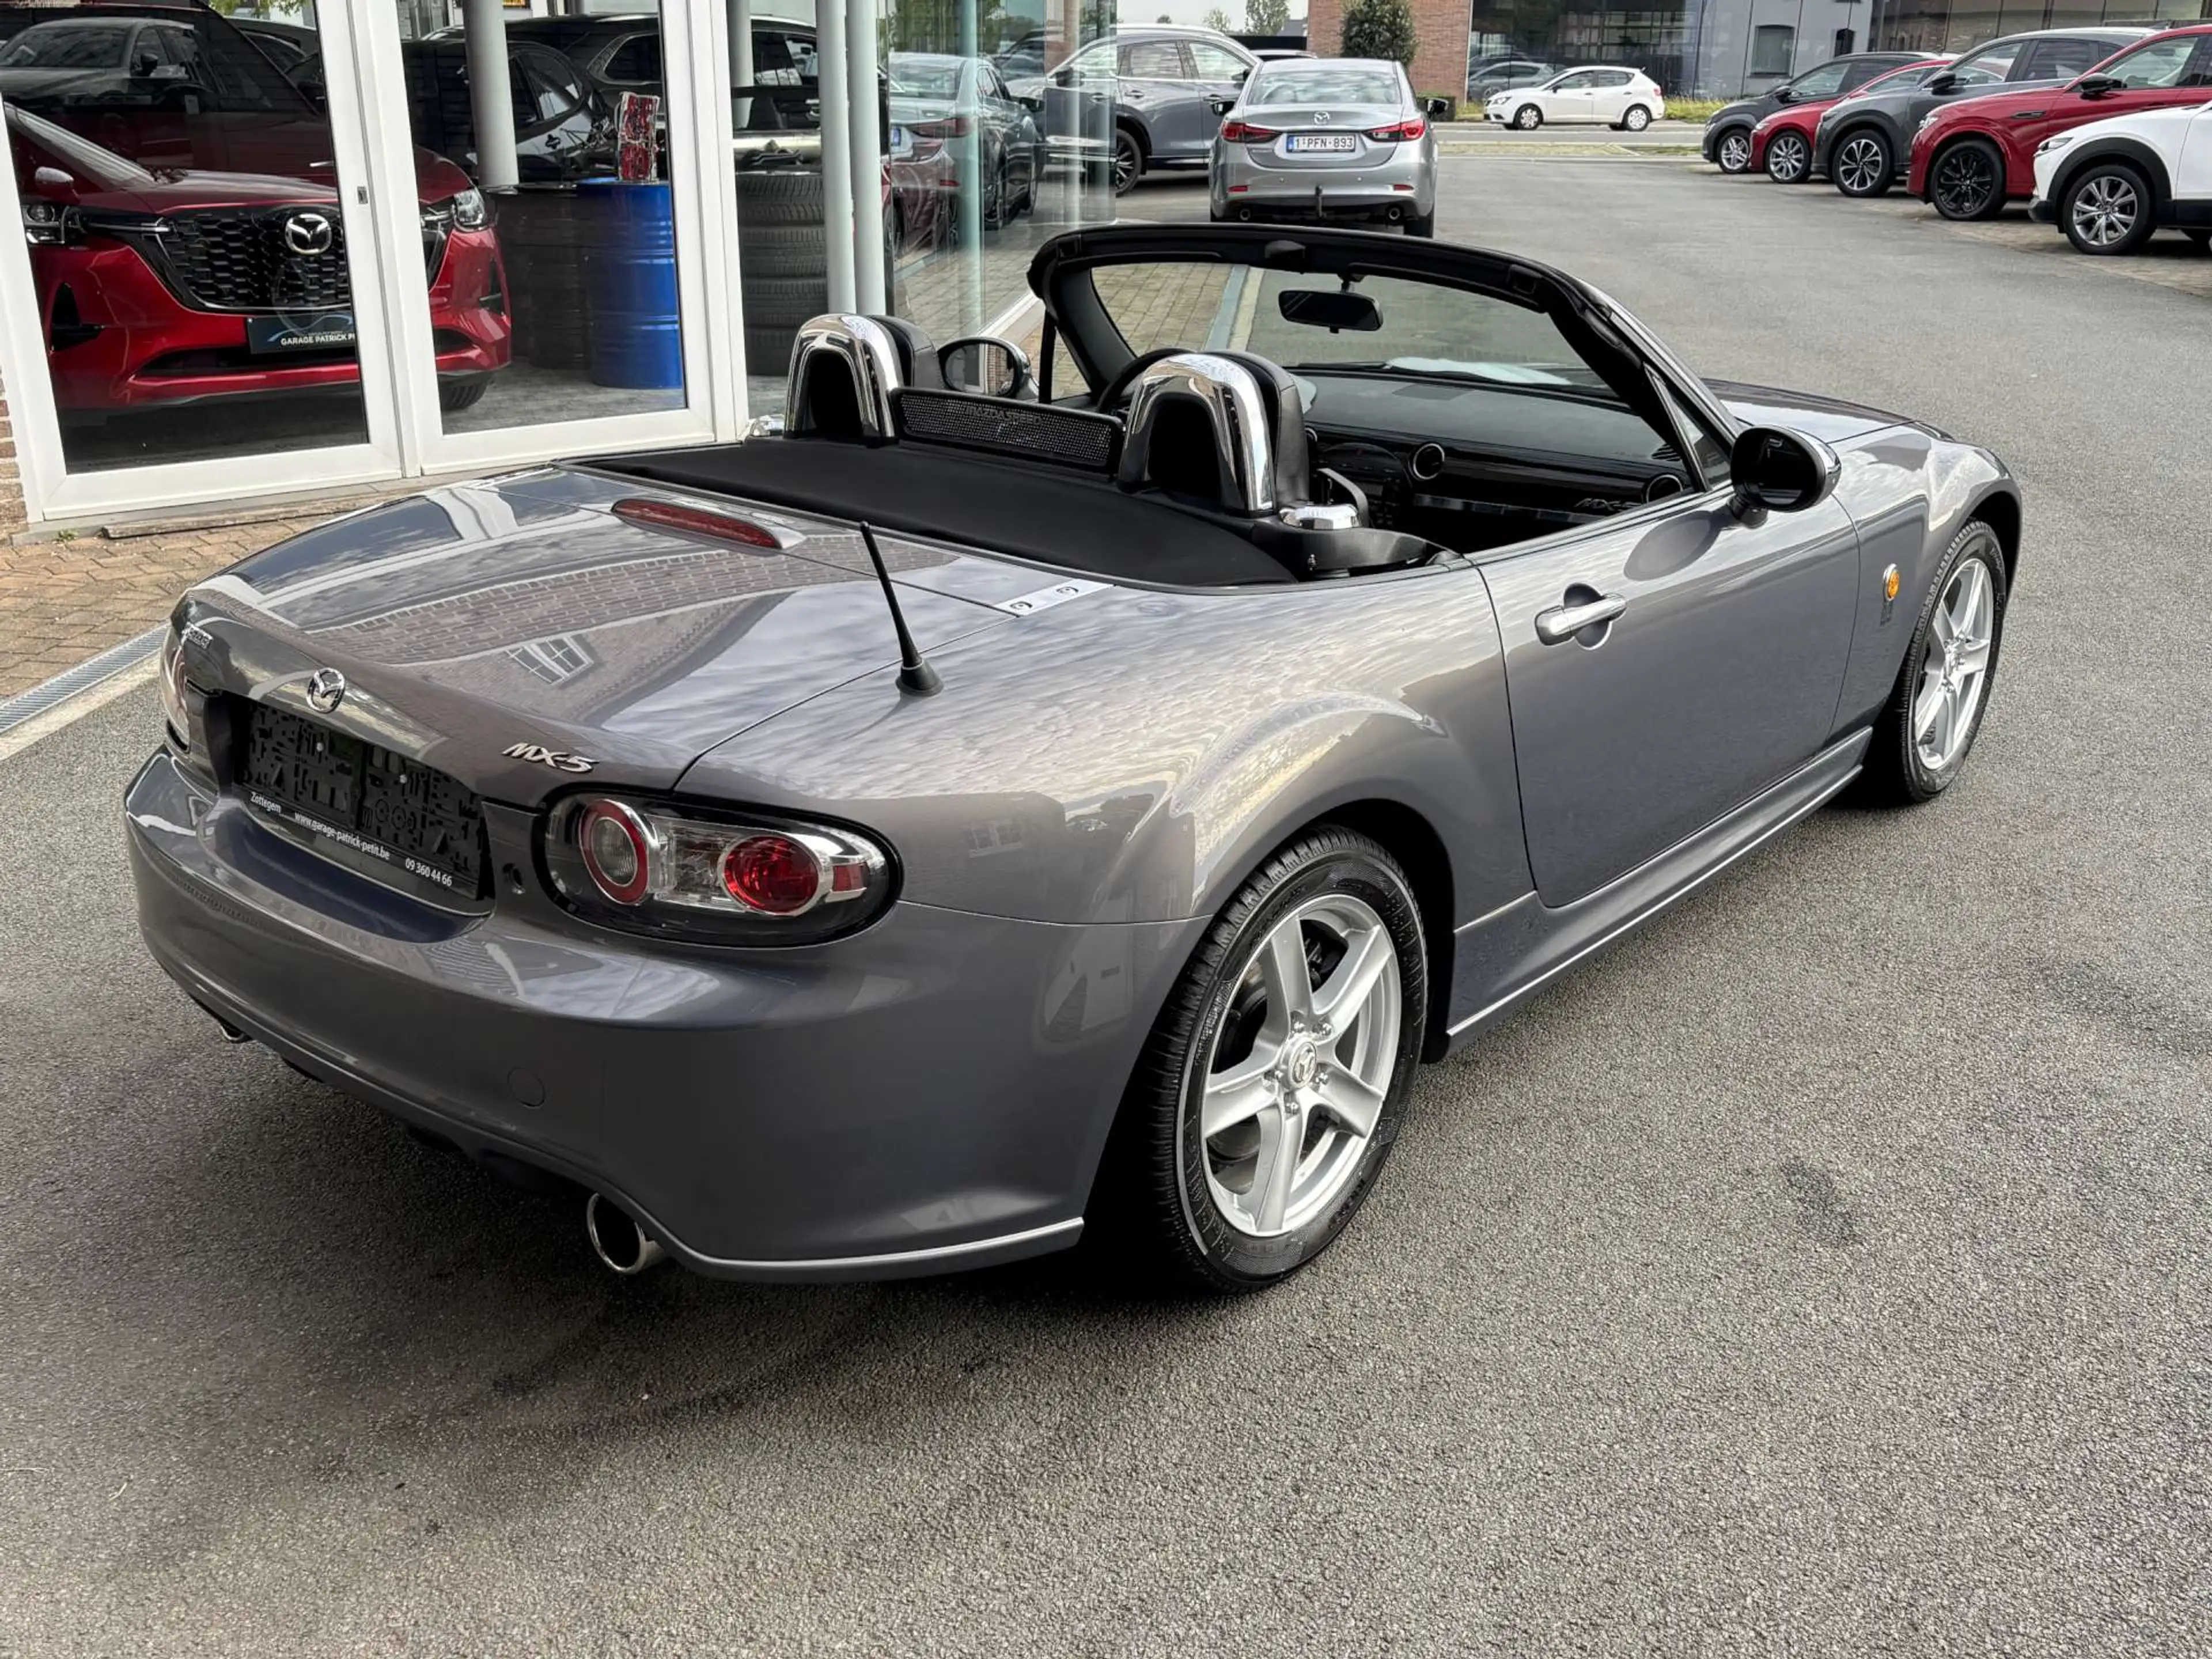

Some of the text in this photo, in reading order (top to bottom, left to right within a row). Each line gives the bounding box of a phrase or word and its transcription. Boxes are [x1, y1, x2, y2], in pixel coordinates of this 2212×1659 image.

[281, 335, 314, 346] GARAGE
[315, 333, 347, 344] PATRICK
[502, 743, 600, 773] MX-5
[250, 791, 453, 887] Zottegem www.garage-patrick-petit.be 09 360 44 66
